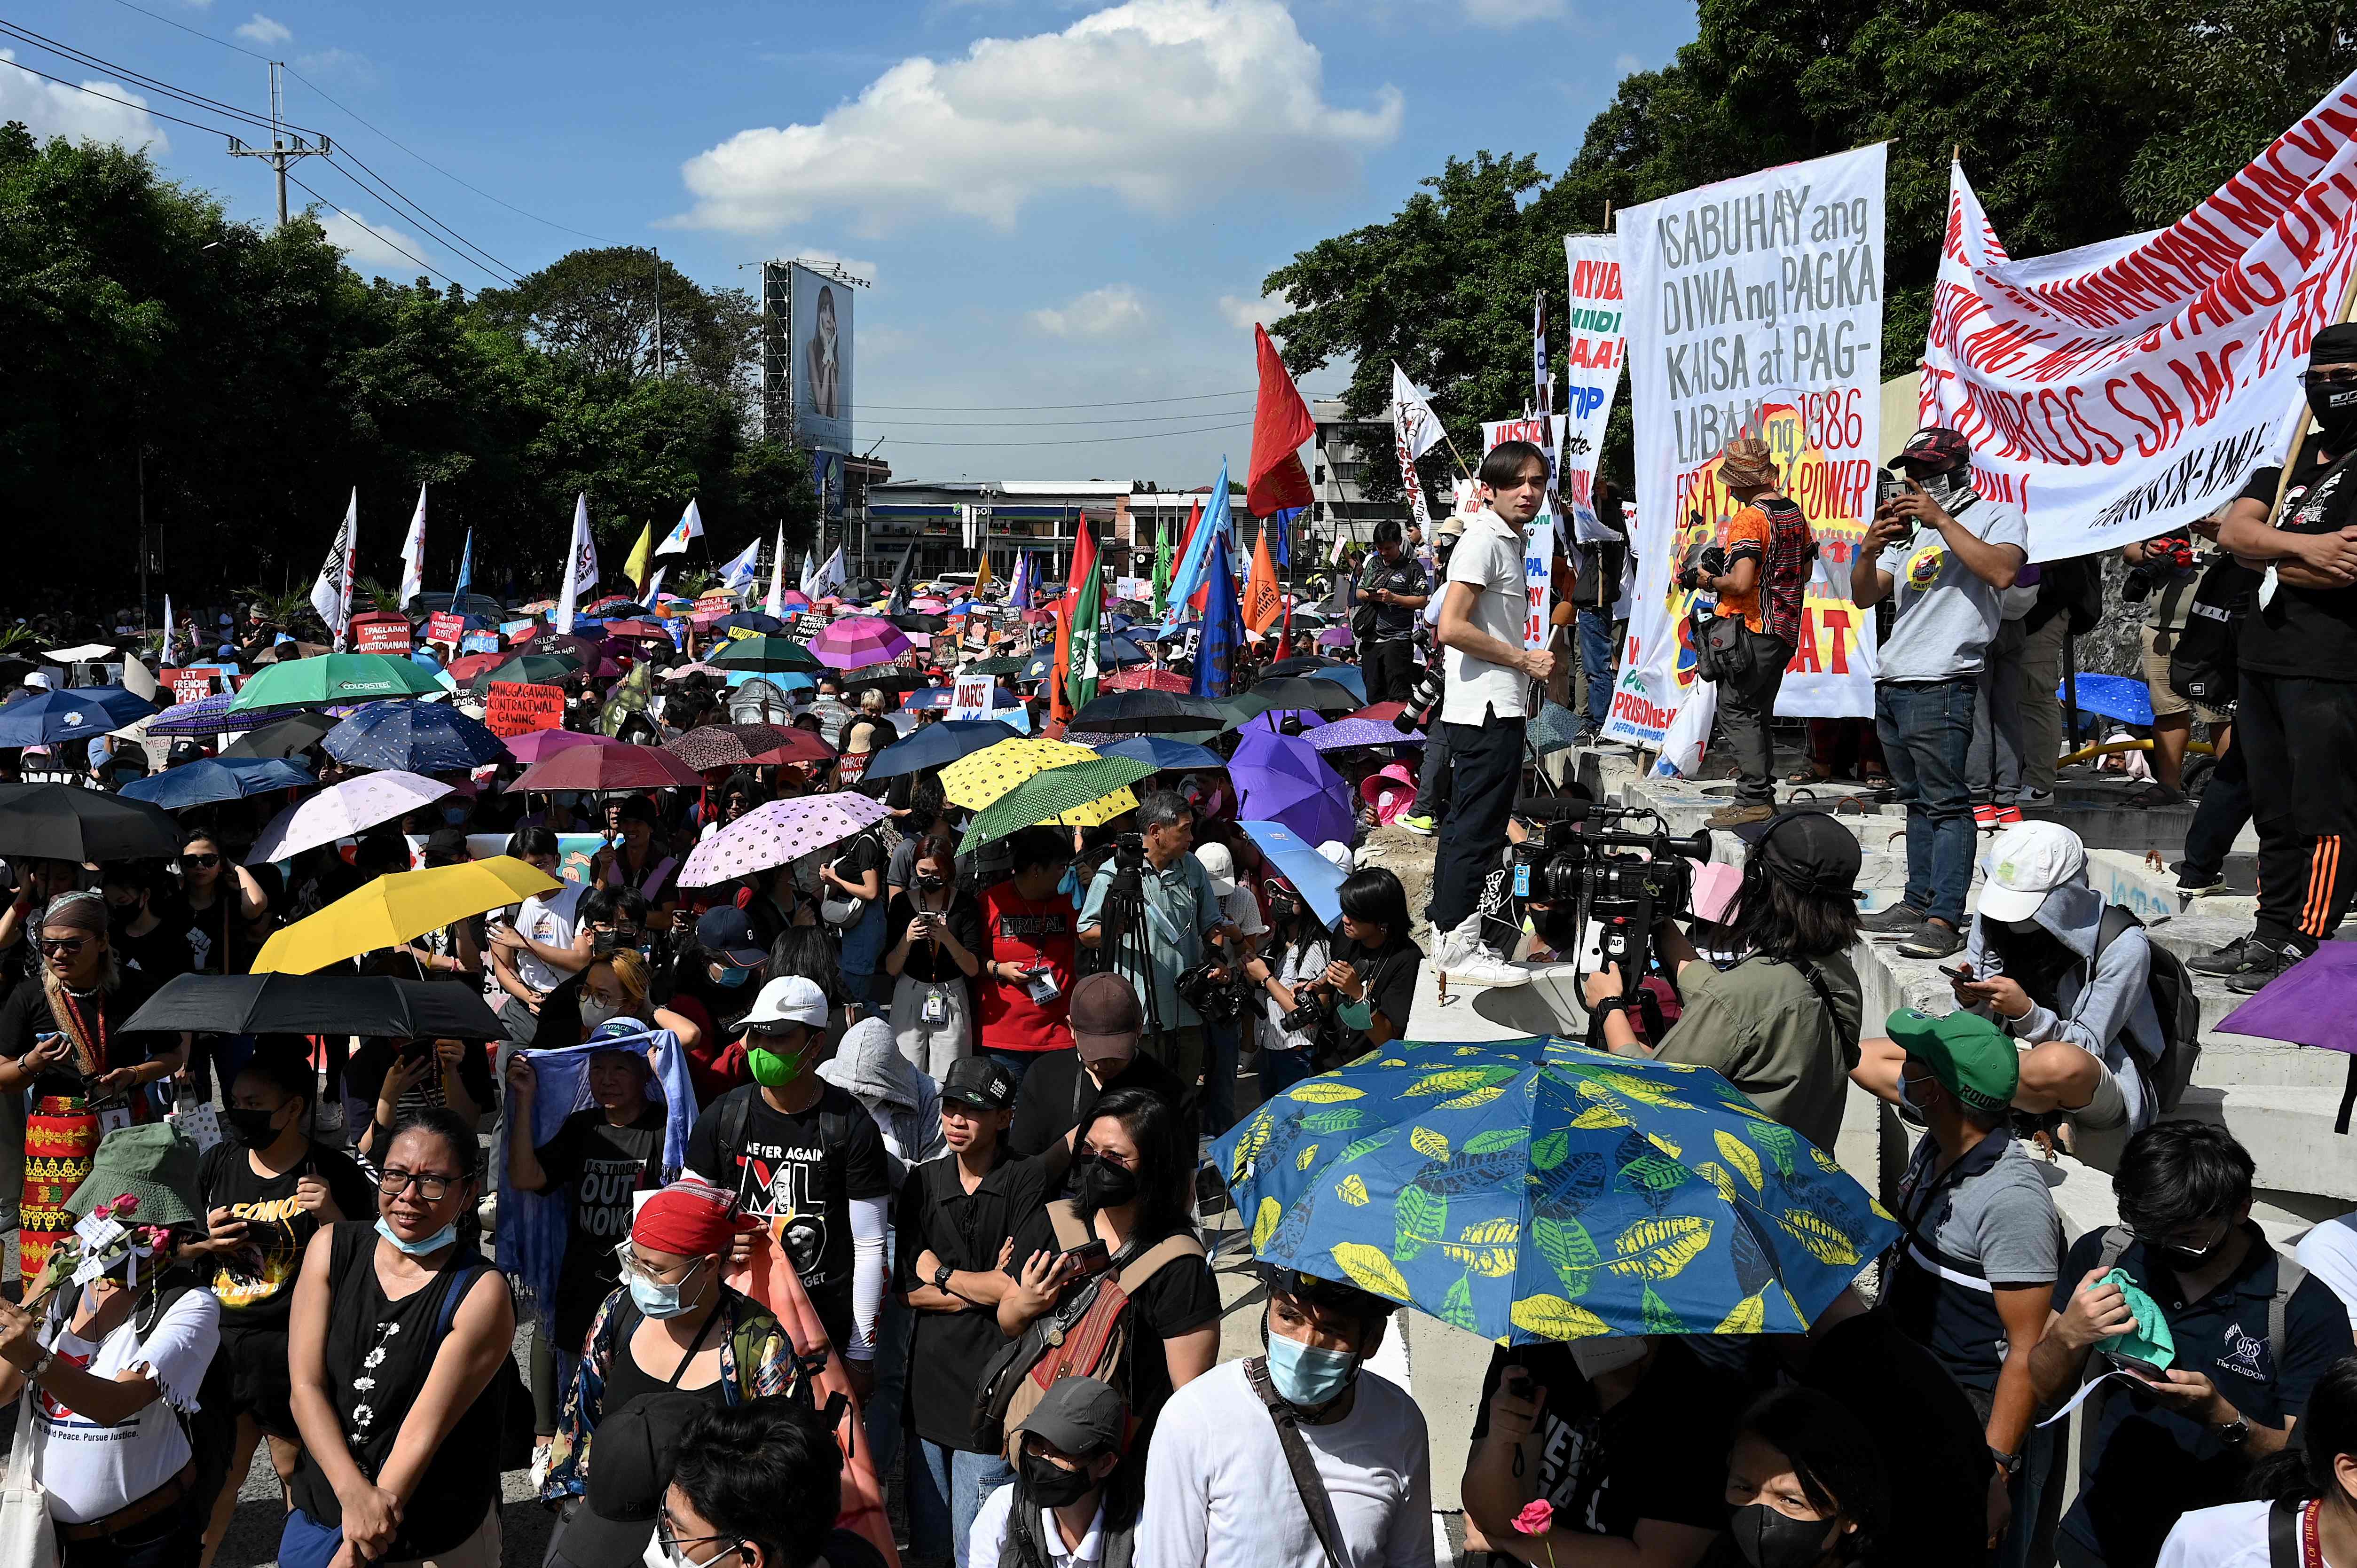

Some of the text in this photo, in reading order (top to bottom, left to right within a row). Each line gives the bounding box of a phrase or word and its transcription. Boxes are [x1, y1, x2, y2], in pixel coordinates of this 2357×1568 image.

[1658, 185, 1868, 271] ISABUHAY ang
[1572, 260, 1623, 300] AYUD
[1664, 244, 1878, 335] DIWA ng PAGKA
[1572, 307, 1622, 334] HINDI
[1666, 320, 1870, 400] KAISA at PAG-
[1569, 386, 1604, 420] TOP
[1673, 397, 1763, 463] LABAN
[1770, 418, 1795, 461] ng
[1798, 388, 1862, 451] 1986
[1976, 383, 2124, 466] MARCOS
[2106, 371, 2184, 458] SA
[1490, 420, 1541, 449] JUSTIC
[1801, 460, 1871, 520] POWER
[695, 598, 715, 608] MARCOS
[801, 615, 827, 624] MARCOS
[2199, 606, 2226, 619] VAN
[364, 625, 408, 635] IPAGLABAN
[432, 620, 462, 633] MANDATORY
[435, 628, 454, 639] ROTC
[360, 641, 410, 652] KATOTOHANAN
[480, 638, 499, 651] EASE
[534, 634, 560, 645] ISULONG
[542, 643, 555, 652] ANG
[181, 670, 197, 679] LET
[173, 679, 210, 689] FRENCHIE
[176, 688, 208, 704] PEAK
[488, 683, 563, 700] MANGGAGAWANG
[489, 698, 557, 713] KONTRAKTWAL
[497, 711, 536, 725] GAWING
[1612, 722, 1636, 736] DEFEND
[145, 739, 171, 749] MEGA
[178, 743, 189, 753] P
[991, 1084, 1005, 1096] FIGHT
[993, 1078, 1007, 1092] Artists
[990, 1088, 1003, 1099] BACK
[746, 1141, 824, 1161] NEVER AGAIN
[606, 1159, 645, 1175] TROOPS
[581, 1172, 636, 1205] OUT
[580, 1205, 634, 1236] NOW
[801, 1272, 826, 1288] GET
[230, 1284, 268, 1296] NEVER
[2216, 1357, 2266, 1382] The GUIDON
[58, 1430, 81, 1441] Peace.
[83, 1433, 109, 1442] Pursue
[110, 1430, 139, 1441] Justice.
[2306, 1522, 2314, 1542] THE
[2308, 1543, 2316, 1557] OF
